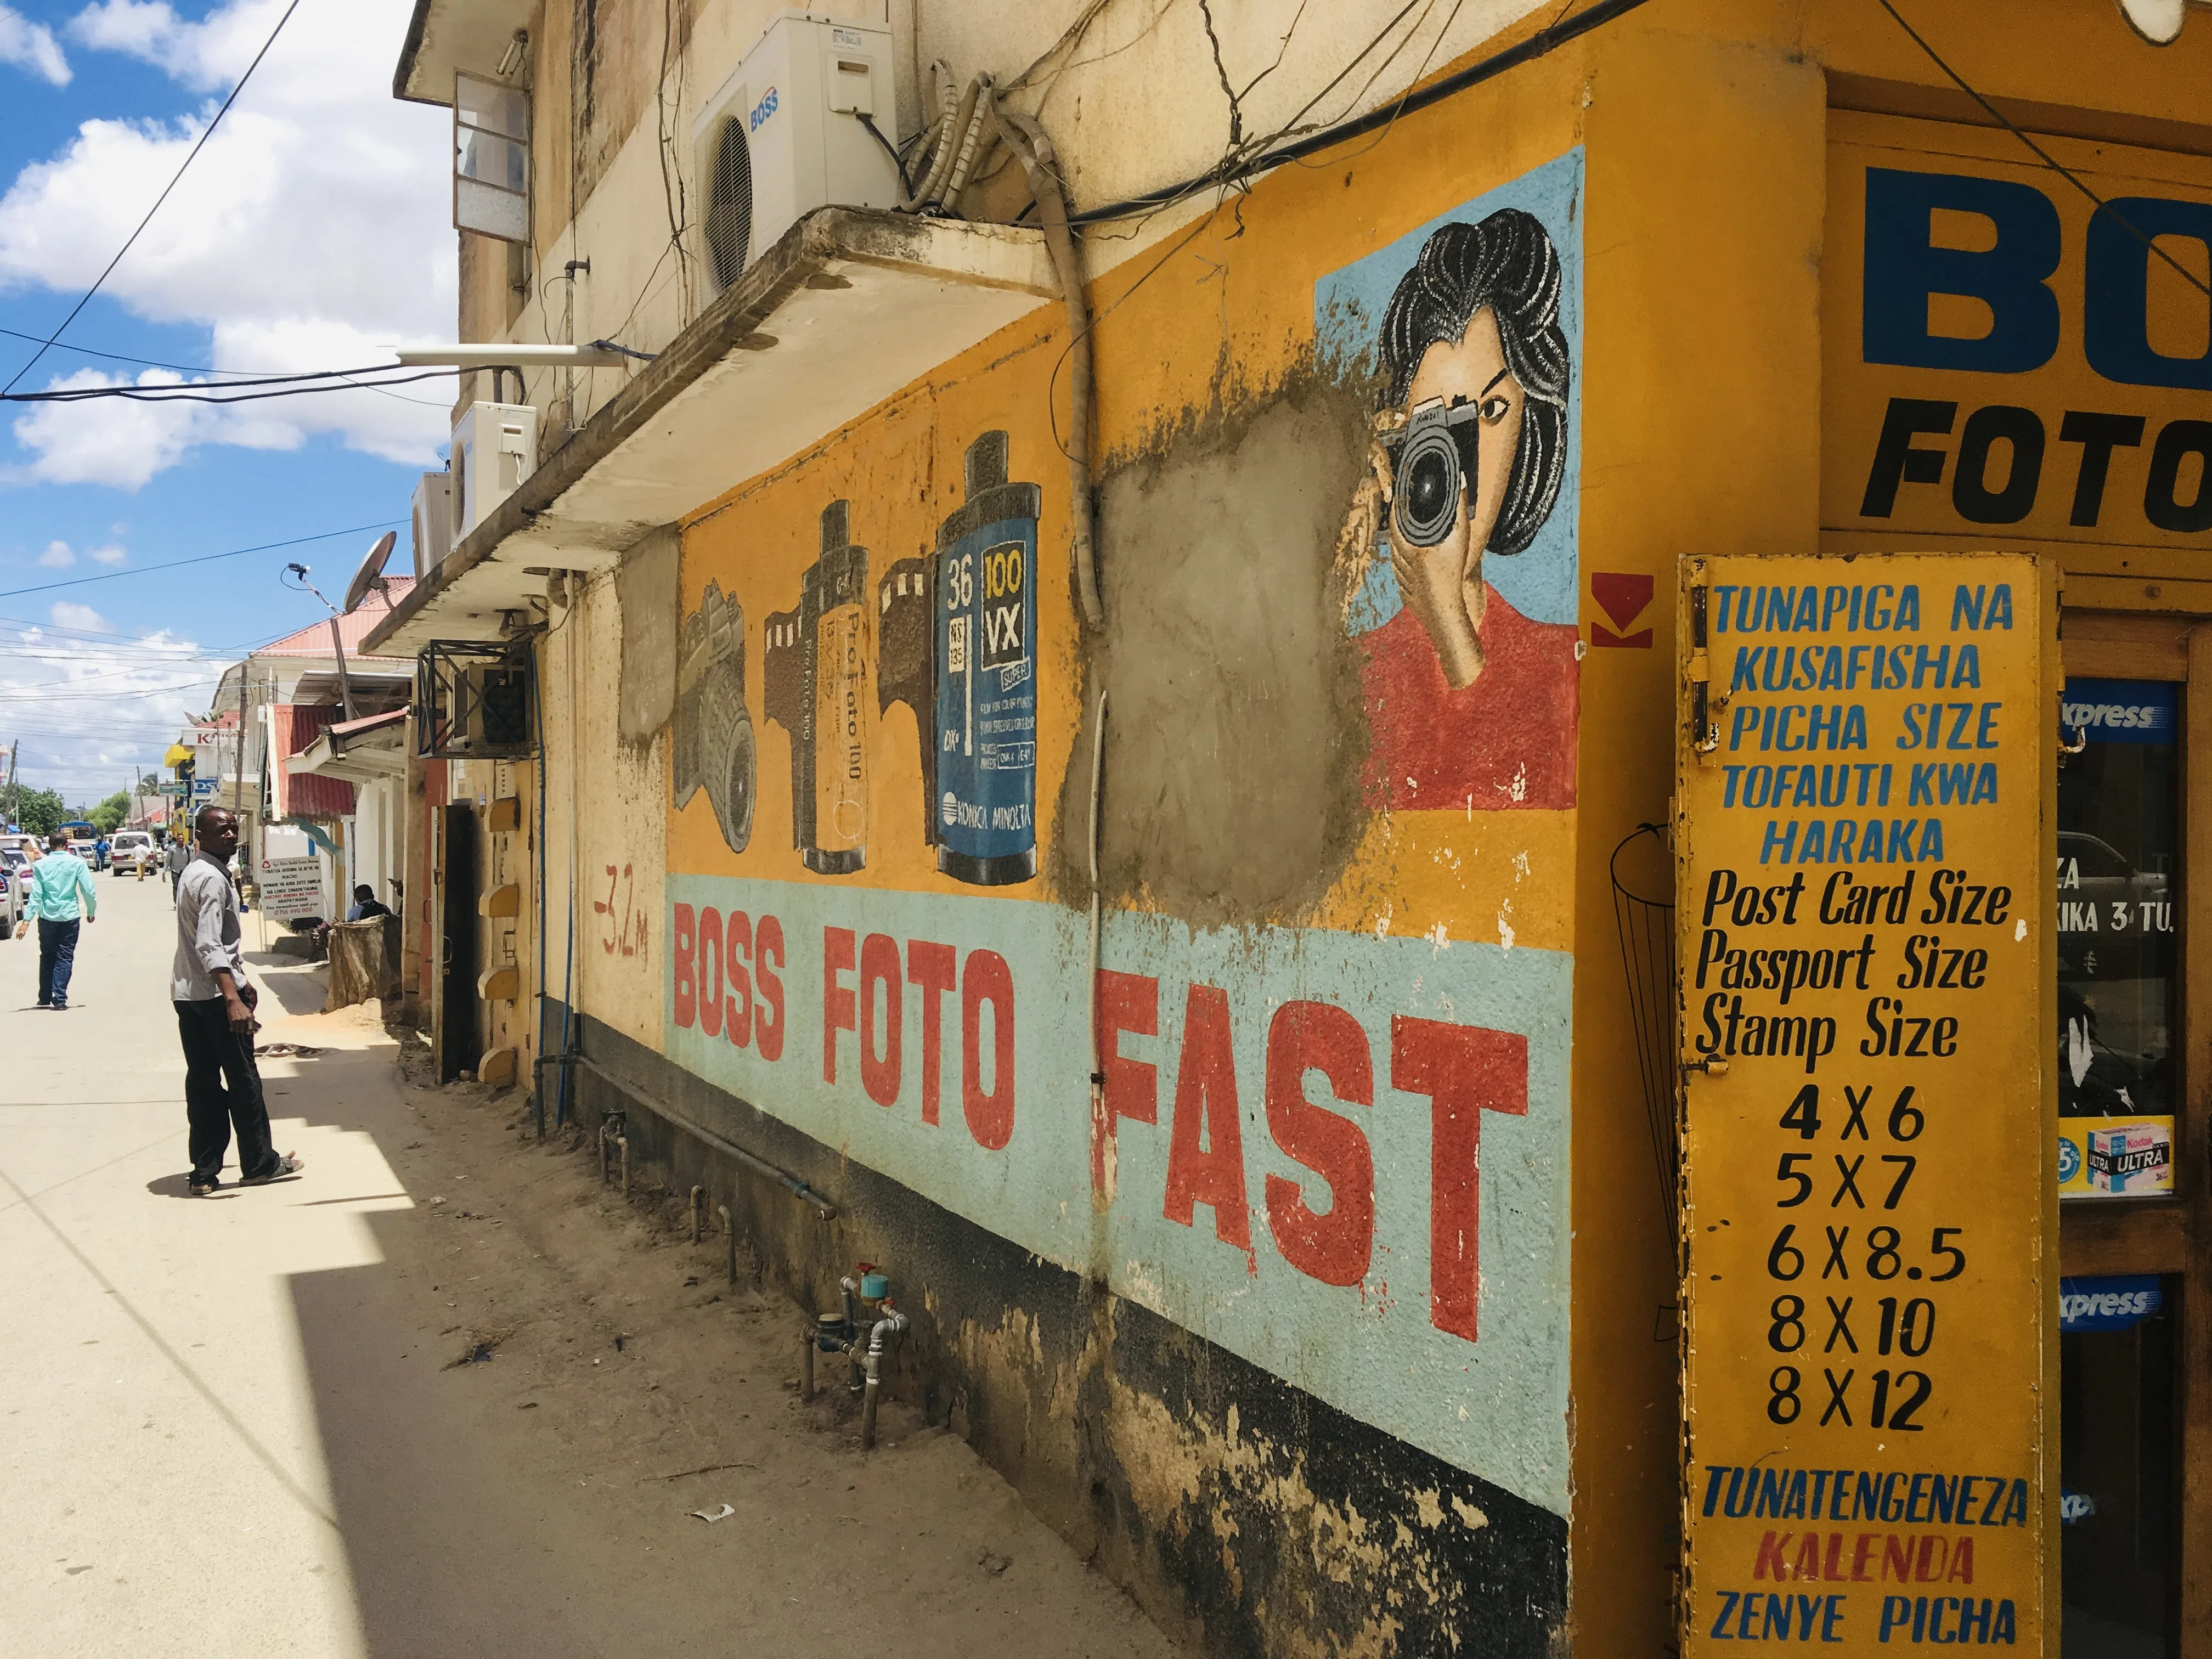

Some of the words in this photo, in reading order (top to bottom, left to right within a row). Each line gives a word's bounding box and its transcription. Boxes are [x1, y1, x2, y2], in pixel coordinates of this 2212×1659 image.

[751, 88, 778, 132] BOSS
[1859, 397, 2212, 533] FOTO
[947, 554, 973, 610] 36
[985, 550, 1022, 599] 100
[951, 623, 962, 644] NS
[985, 602, 1020, 654] VX
[1714, 585, 1920, 633] TUNAPIGA
[1950, 584, 2013, 631] NA
[950, 647, 962, 665] 135
[1004, 663, 1026, 686] SUPER
[1733, 644, 1981, 691] KUSAFISHA
[1730, 704, 1867, 751] PICHA
[1897, 702, 2002, 750] SIZE
[1722, 764, 1892, 808] TOFAUTI
[1909, 763, 1999, 806] KWA
[958, 801, 988, 830] KONICA
[992, 803, 1031, 830] MINOLTA
[1760, 819, 1944, 864] HARAKA
[1702, 870, 1805, 926] Post
[1819, 870, 1915, 924] Card
[1921, 870, 2011, 924] Size
[2139, 902, 2174, 933] TU.
[1696, 929, 1878, 1006] Passport
[1897, 935, 1988, 989] Size
[1696, 991, 1836, 1074] Stamp
[1860, 996, 1959, 1057] Size
[674, 902, 785, 1062] BOSS
[823, 926, 1015, 1150] FOTO
[1091, 969, 1528, 1343] FAST
[1780, 1084, 1821, 1139] 4
[1841, 1085, 1873, 1141] X
[1888, 1086, 1925, 1142] 6
[1776, 1153, 1813, 1208] 5
[1831, 1154, 1865, 1209] X
[1882, 1155, 1916, 1210] 7
[2089, 1154, 2109, 1172] ULTRA
[2118, 1149, 2163, 1172] ULTRA
[1767, 1224, 1804, 1281] 6
[1866, 1226, 1966, 1282] 8.5
[1767, 1295, 1805, 1353] 8
[1824, 1296, 1859, 1354] X
[1878, 1297, 1936, 1357] 10
[1767, 1365, 1801, 1425] 8
[1820, 1368, 1855, 1427] X
[1871, 1369, 1932, 1431] 12
[1702, 1465, 2028, 1527] TUNATENGENEZA
[1753, 1531, 1974, 1584] KALENDA
[1710, 1590, 1847, 1643] ZENYE
[1879, 1596, 2016, 1645] PICHA
